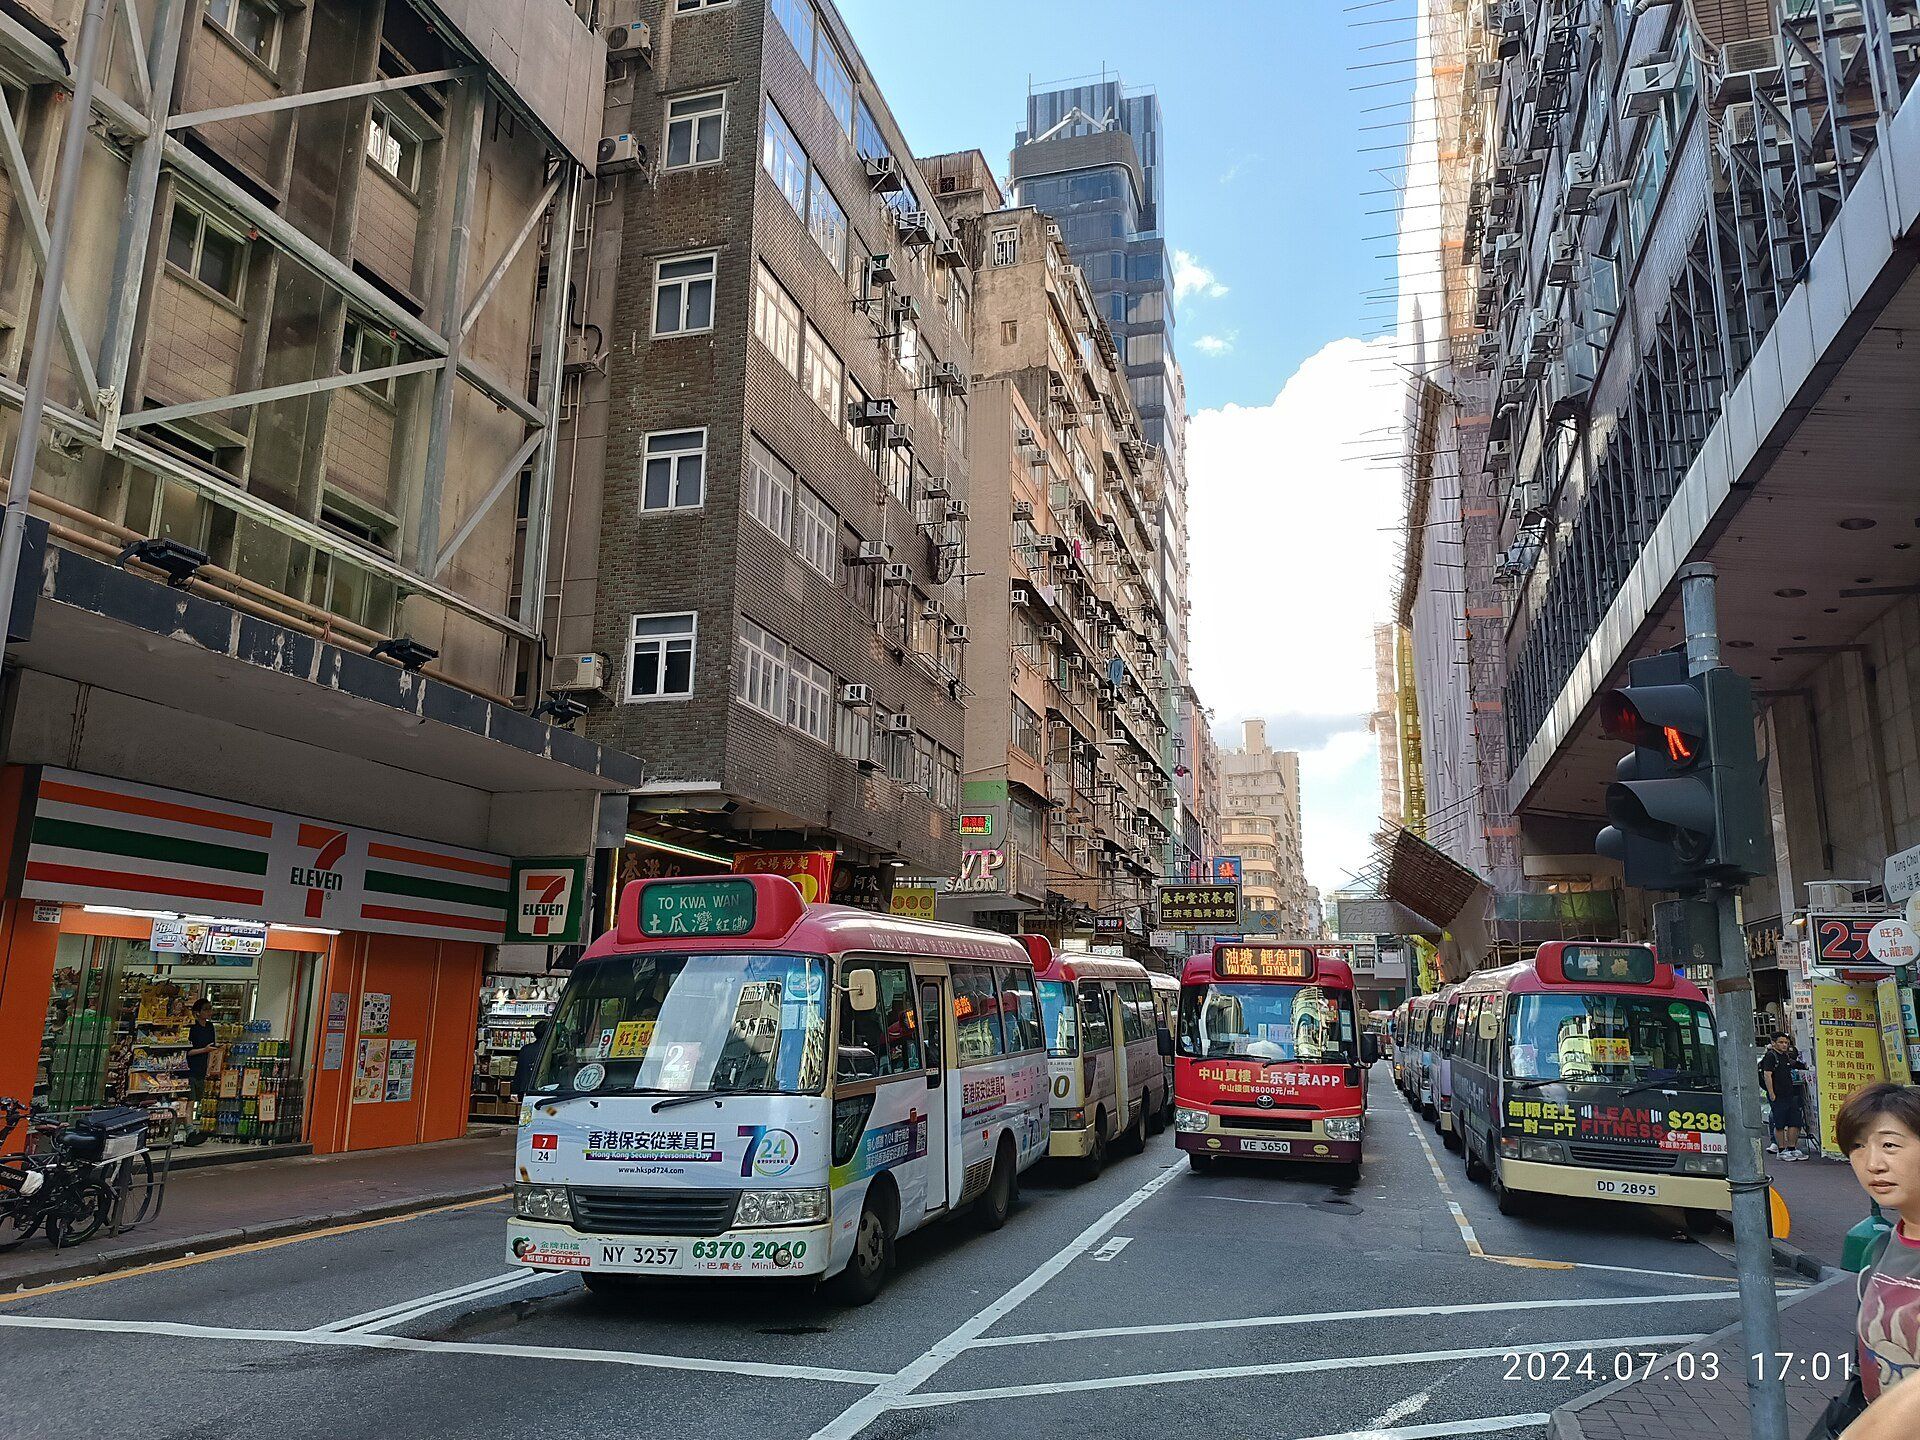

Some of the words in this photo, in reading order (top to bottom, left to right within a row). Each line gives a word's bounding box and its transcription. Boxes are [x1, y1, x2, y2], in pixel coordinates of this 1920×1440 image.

[297, 823, 348, 918] 7
[1894, 860, 1907, 873] Tung
[945, 877, 998, 893] SALON
[526, 875, 566, 935] 7
[658, 897, 672, 910] TO
[680, 895, 706, 909] KWA
[713, 894, 739, 908] WAN
[649, 911, 713, 934] 土瓜灣
[1880, 927, 1904, 938] 旺角
[1226, 948, 1253, 965] 油塘
[1260, 948, 1301, 966] 鯉魚門
[1580, 949, 1604, 957] KWUN
[1199, 1067, 1251, 1083] 中山買樓
[1508, 1101, 1576, 1121] 無限任上
[1593, 1105, 1650, 1123] LEAN
[1508, 1119, 1577, 1137] 一對一PT
[1581, 1119, 1663, 1139] FITNESS
[1668, 1110, 1727, 1131] $238
[541, 1138, 549, 1147] 7
[588, 1130, 716, 1151] 香港保安從業員日
[760, 1138, 787, 1158] 24
[1242, 1140, 1257, 1150] VE
[1260, 1141, 1288, 1152] 3650
[537, 1150, 549, 1162] 24
[591, 1151, 609, 1160] Hong
[611, 1151, 629, 1160] Kong
[630, 1151, 659, 1161] Security
[660, 1151, 695, 1160] Personnel
[696, 1151, 712, 1161] Day
[618, 1166, 685, 1175] www.hkspd724.com
[1597, 1180, 1615, 1192] DD
[1621, 1183, 1656, 1195] 2895
[602, 1246, 623, 1264] NY
[632, 1247, 679, 1265] 3257
[692, 1241, 746, 1259] 6370
[694, 1262, 742, 1271] 小巴廣告
